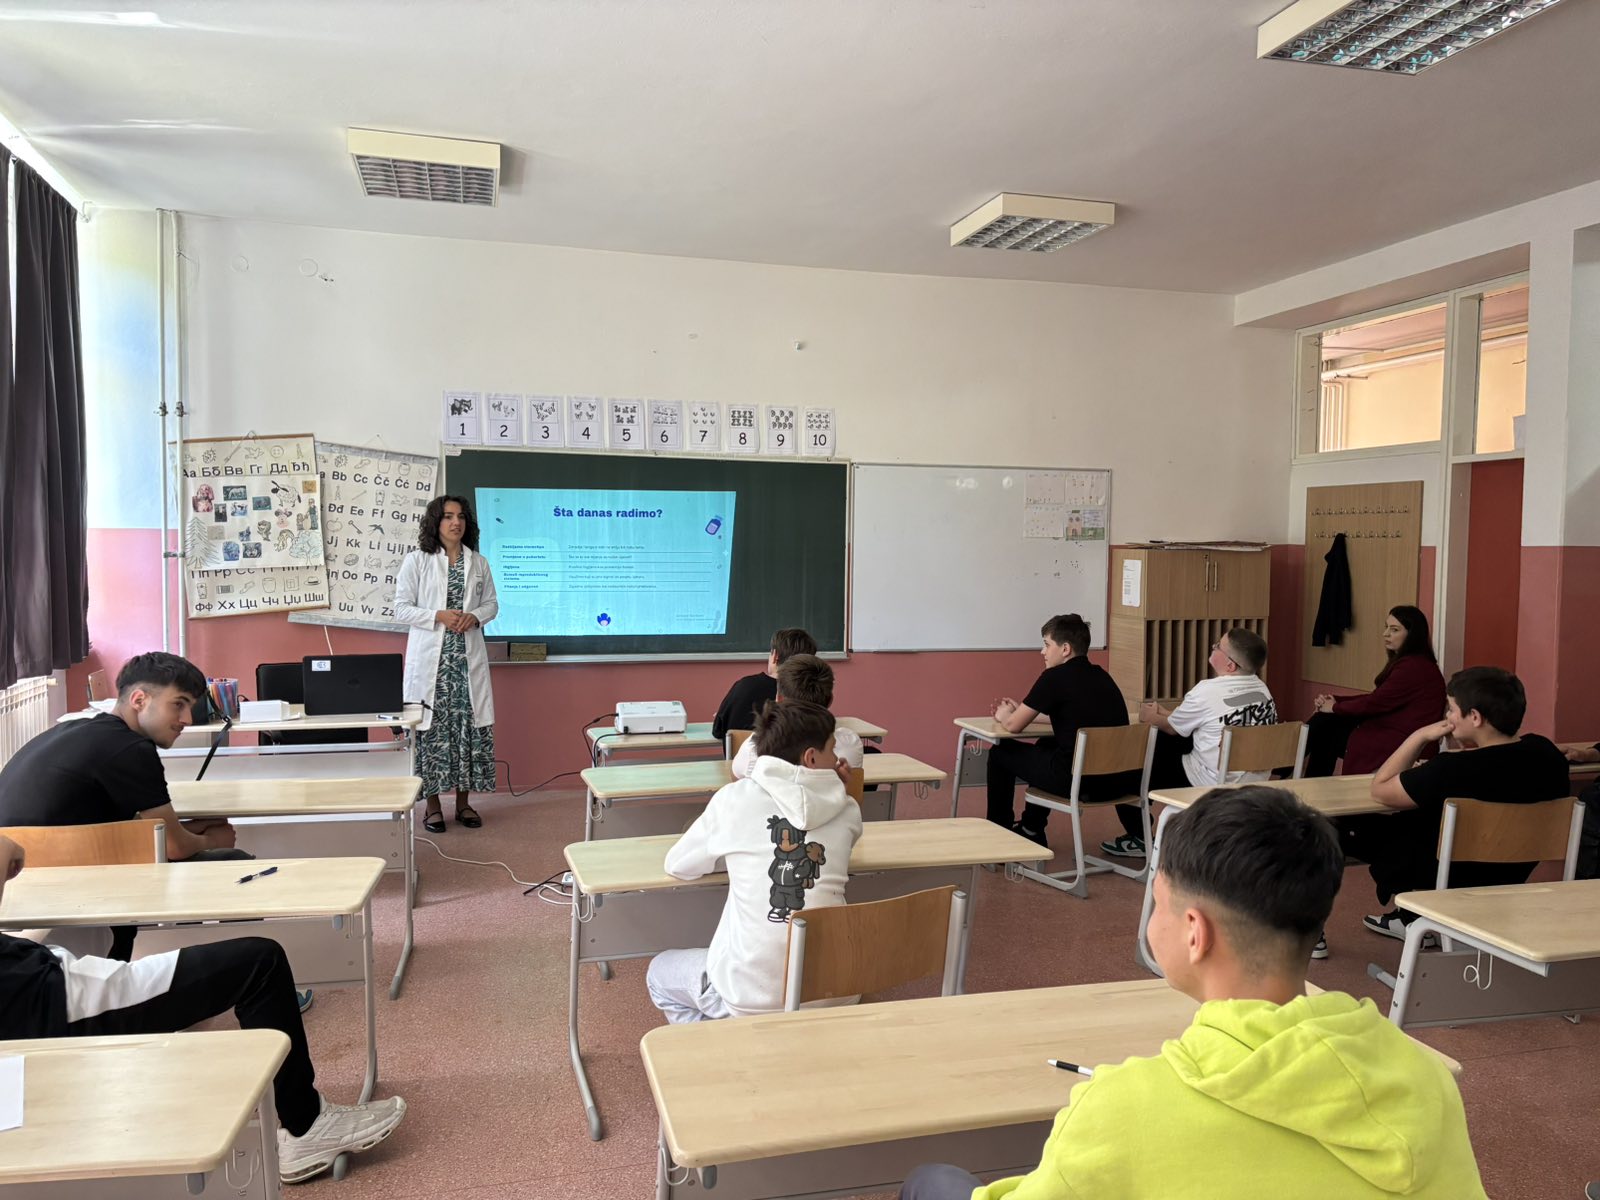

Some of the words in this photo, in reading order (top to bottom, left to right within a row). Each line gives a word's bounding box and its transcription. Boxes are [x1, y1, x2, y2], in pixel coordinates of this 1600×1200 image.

[459, 422, 466, 436] 1
[500, 424, 508, 438] 2
[541, 425, 550, 439] 3
[581, 426, 591, 440] 4
[622, 428, 631, 442] 5
[660, 429, 669, 443] 6
[698, 430, 708, 443] 7
[738, 432, 747, 445] 8
[776, 433, 785, 447] 9
[812, 433, 827, 447] 10
[201, 466, 221, 477] Бб
[224, 465, 243, 475] Вв
[249, 464, 262, 474] Гг
[270, 463, 289, 474] Дд
[291, 461, 310, 472] Ђђ
[332, 471, 347, 481] Bb
[353, 473, 368, 484] Cc
[373, 474, 390, 486] Čč
[395, 476, 410, 489] Ćć
[416, 481, 431, 492] Dd
[328, 503, 344, 514] Đđ
[350, 505, 364, 516] Ee
[371, 508, 384, 518] Ff
[391, 510, 407, 523] Gg
[553, 505, 573, 518] Šta
[577, 507, 613, 518] danas
[616, 508, 663, 518] radimo?
[327, 536, 338, 547] Jj
[346, 538, 360, 548] Kk
[342, 570, 358, 580] Oo
[364, 573, 378, 584] Pp
[195, 602, 213, 611] Фф
[218, 600, 236, 610] Хх
[239, 599, 258, 609] Цц
[262, 597, 279, 605] Чч
[283, 594, 301, 605] Џџ
[304, 593, 324, 602] Шш
[338, 602, 354, 612] Uu
[361, 605, 374, 614] Vv
[381, 606, 395, 617] Zz
